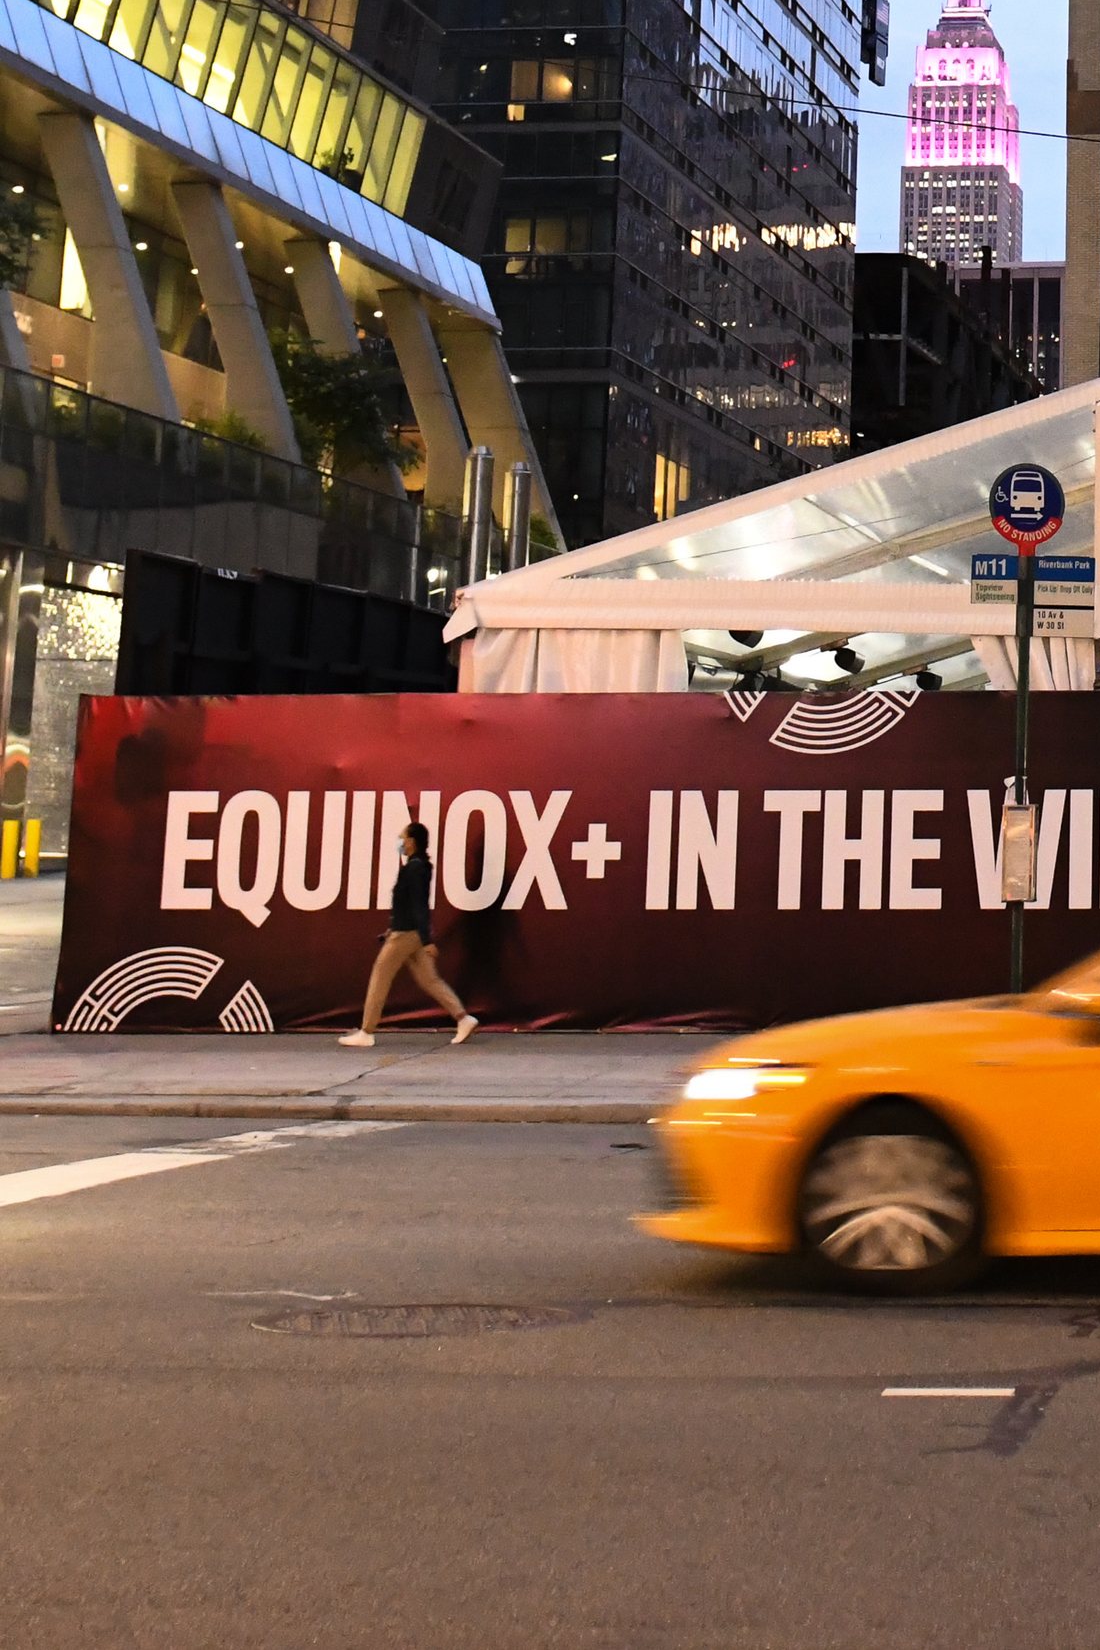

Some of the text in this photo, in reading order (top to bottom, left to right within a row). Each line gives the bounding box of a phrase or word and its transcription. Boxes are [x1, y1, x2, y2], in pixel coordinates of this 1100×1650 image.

[998, 518, 1057, 541] NO STANDING
[975, 558, 1007, 576] M11
[1038, 560, 1090, 569] Riverbank Park
[1038, 611, 1064, 619] 10 Av &
[1037, 622, 1065, 630] W 30 St
[645, 790, 739, 910] IN
[763, 789, 943, 910] THE
